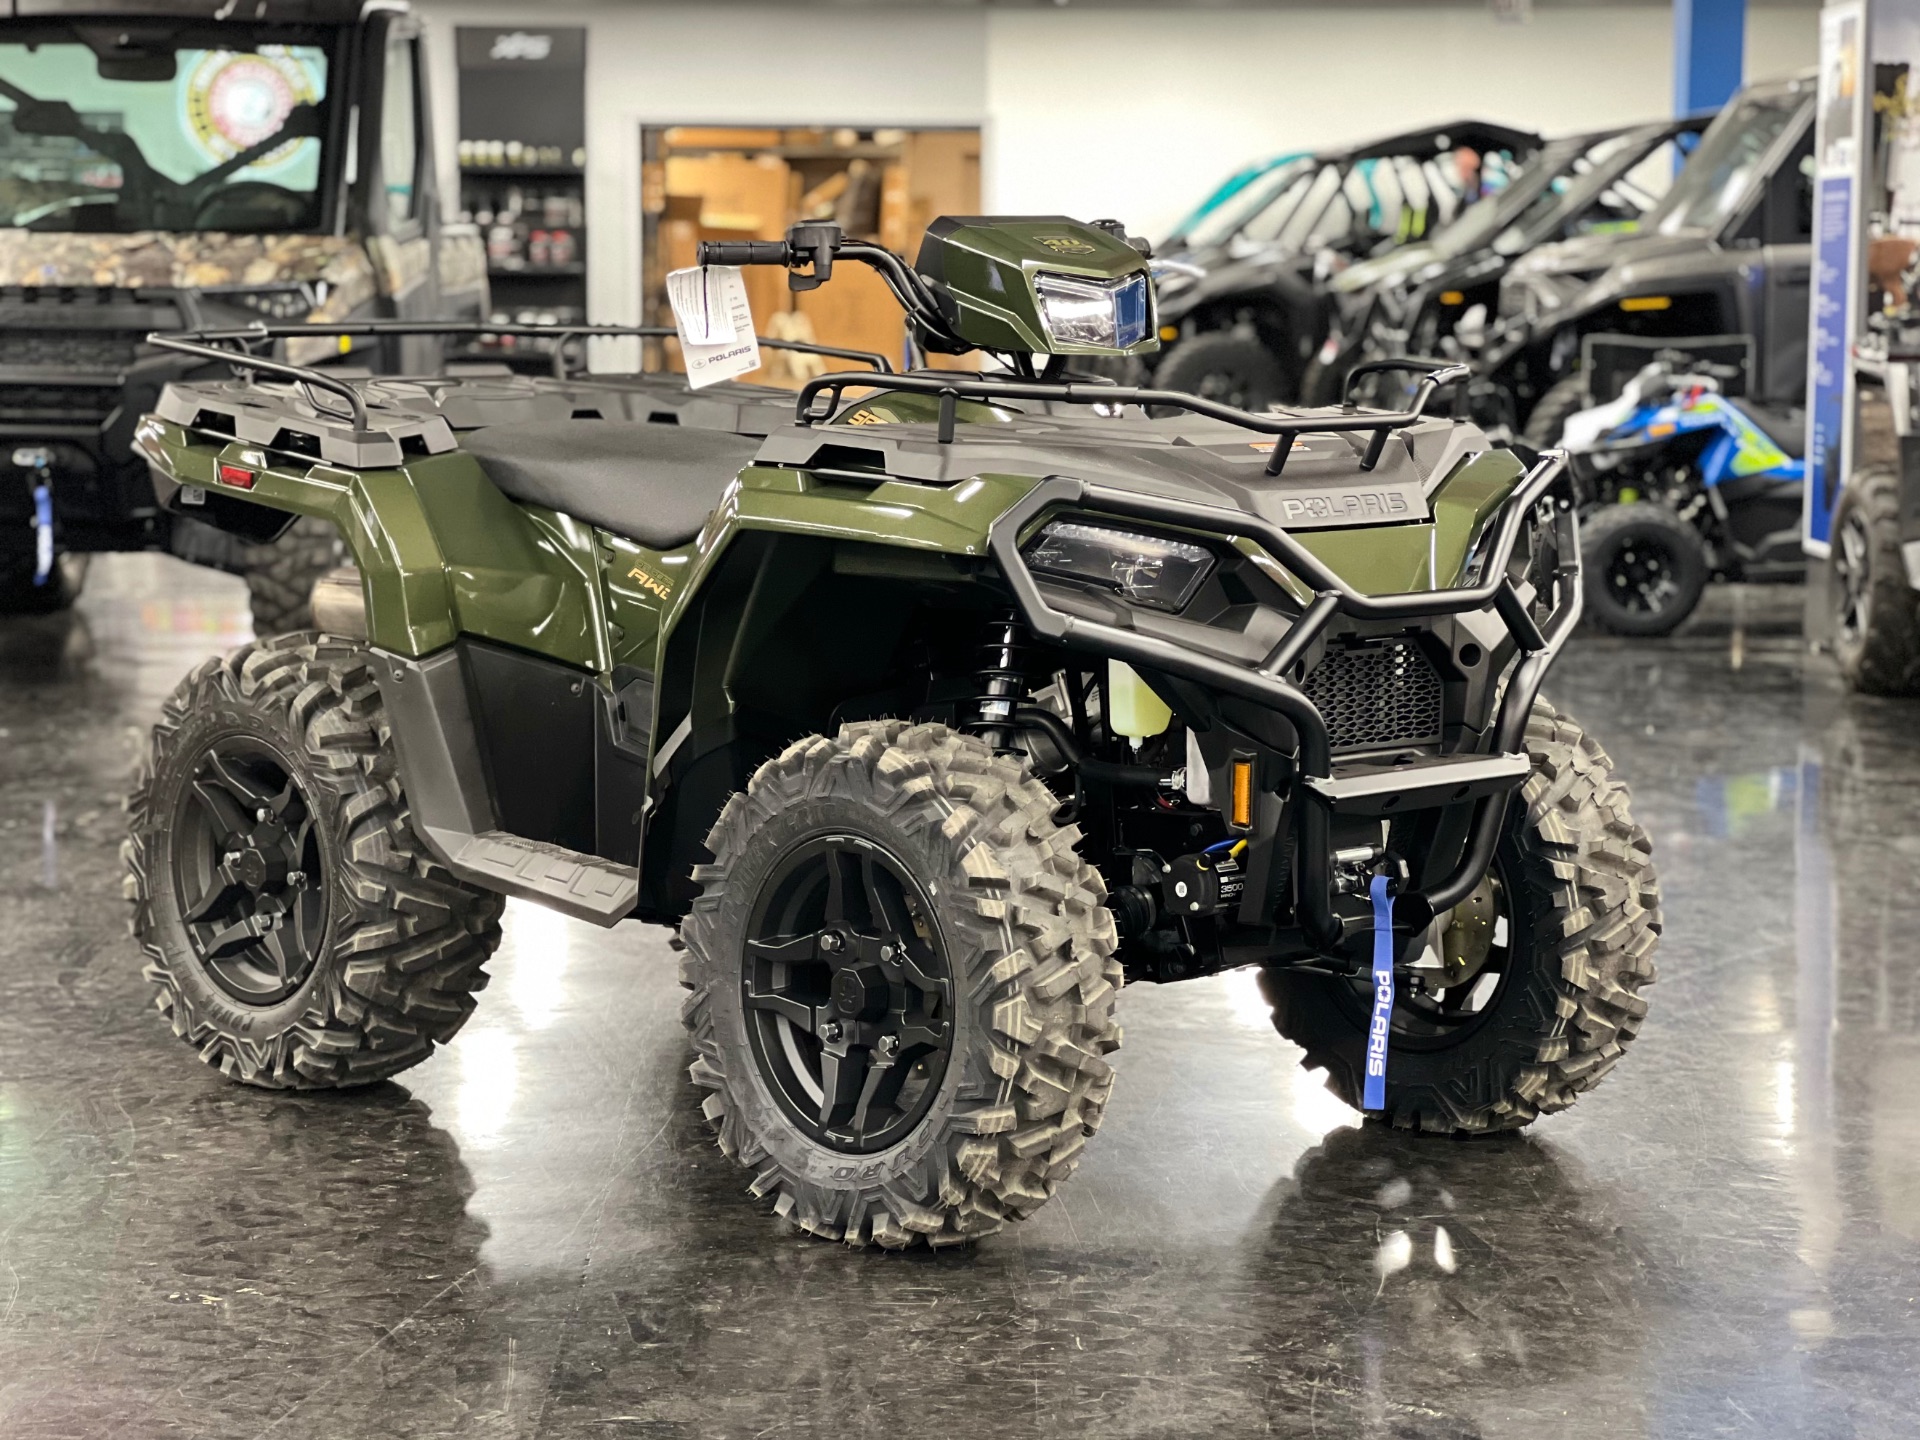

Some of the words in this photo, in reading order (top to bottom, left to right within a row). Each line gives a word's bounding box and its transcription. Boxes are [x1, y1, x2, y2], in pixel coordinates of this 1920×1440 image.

[708, 345, 751, 364] POLARIS
[847, 409, 889, 425] SP
[1282, 492, 1408, 520] POLARIS
[1368, 971, 1389, 1076] POLARIS
[833, 1119, 932, 1181] DURO
